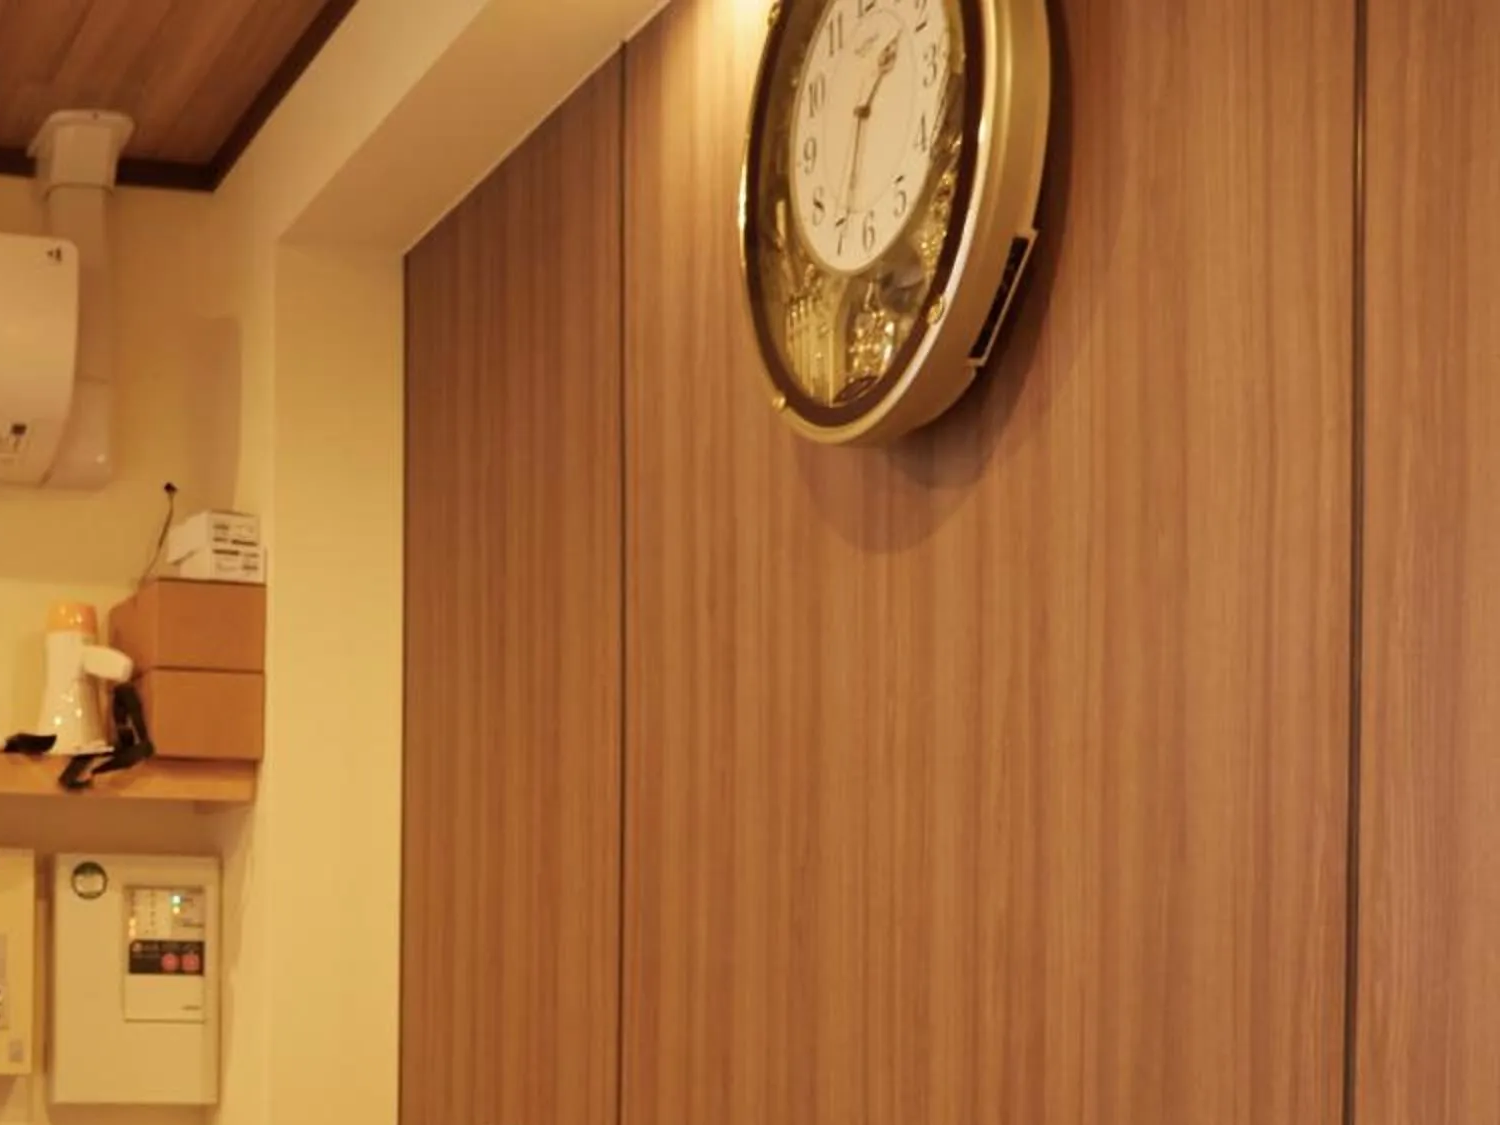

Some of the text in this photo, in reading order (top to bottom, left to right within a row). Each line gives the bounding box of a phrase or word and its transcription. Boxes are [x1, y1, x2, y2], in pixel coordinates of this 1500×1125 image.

[828, 10, 844, 58] 11
[923, 43, 938, 88] 3
[808, 74, 826, 118] 10
[914, 113, 928, 153] 4
[803, 136, 817, 175] 9
[812, 186, 825, 226] 8
[893, 174, 907, 217] 5
[835, 216, 846, 256] 7
[862, 209, 876, 250] 6
